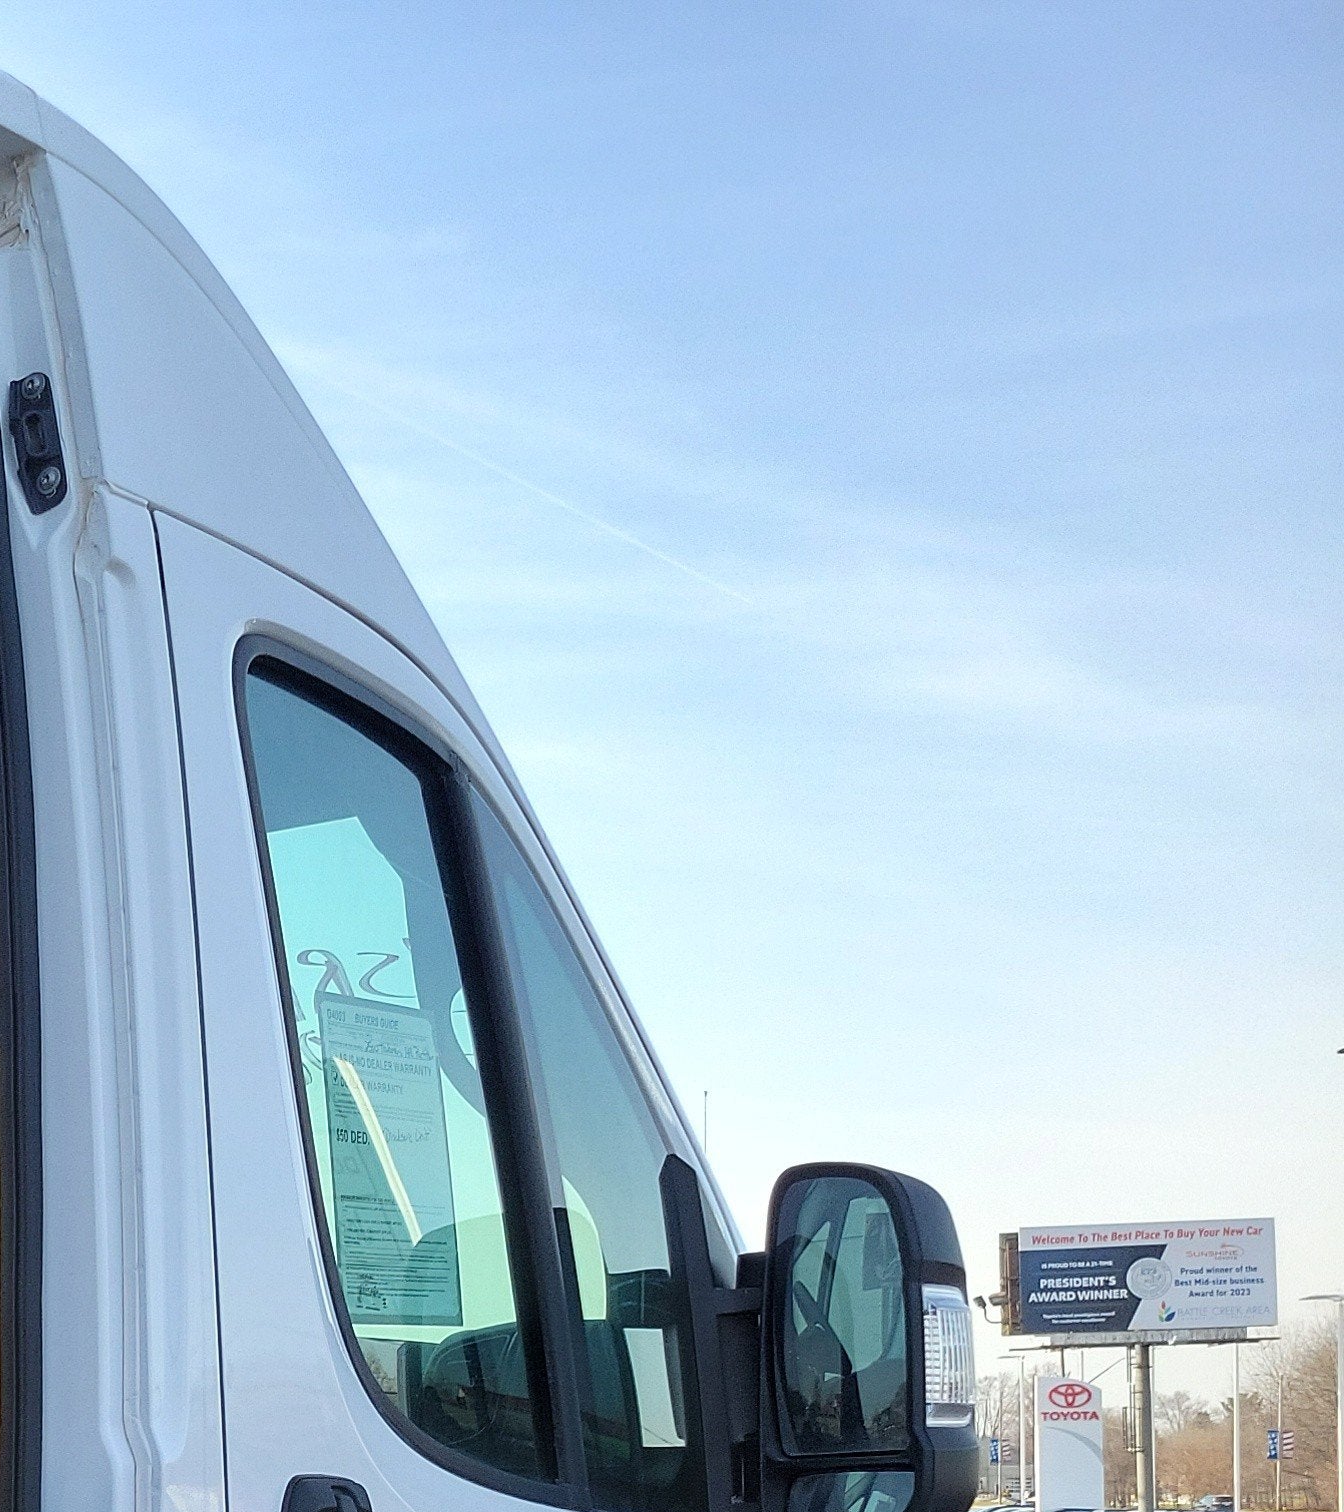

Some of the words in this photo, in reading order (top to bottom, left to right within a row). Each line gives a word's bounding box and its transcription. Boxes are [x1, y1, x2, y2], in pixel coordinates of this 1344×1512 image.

[354, 1013, 379, 1027] BUYERS
[379, 1017, 399, 1030] GUIDE
[366, 1057, 393, 1070] DEALER
[394, 1062, 432, 1077] WARRANTY
[336, 1128, 349, 1143] $50
[350, 1130, 370, 1146] DED.
[1032, 1234, 1074, 1245] Welcome
[1078, 1233, 1088, 1243] To
[1091, 1232, 1108, 1242] The
[1111, 1231, 1132, 1241] Best
[1134, 1230, 1160, 1240] Place
[1164, 1229, 1174, 1239] To
[1176, 1228, 1196, 1240] Buy
[1198, 1228, 1220, 1238] Your
[1223, 1226, 1244, 1237] New
[1246, 1226, 1263, 1236] Car
[1180, 1267, 1204, 1275] Proud
[1206, 1266, 1233, 1274] winner
[1244, 1265, 1258, 1273] the
[1039, 1275, 1117, 1289] PRESIDENT'S
[1174, 1279, 1192, 1287] Best
[1229, 1277, 1265, 1285] business
[1028, 1291, 1077, 1303] AWARD
[1077, 1288, 1129, 1301] WINNER
[1188, 1289, 1214, 1298] Award
[1041, 1411, 1100, 1421] TOYOTA
